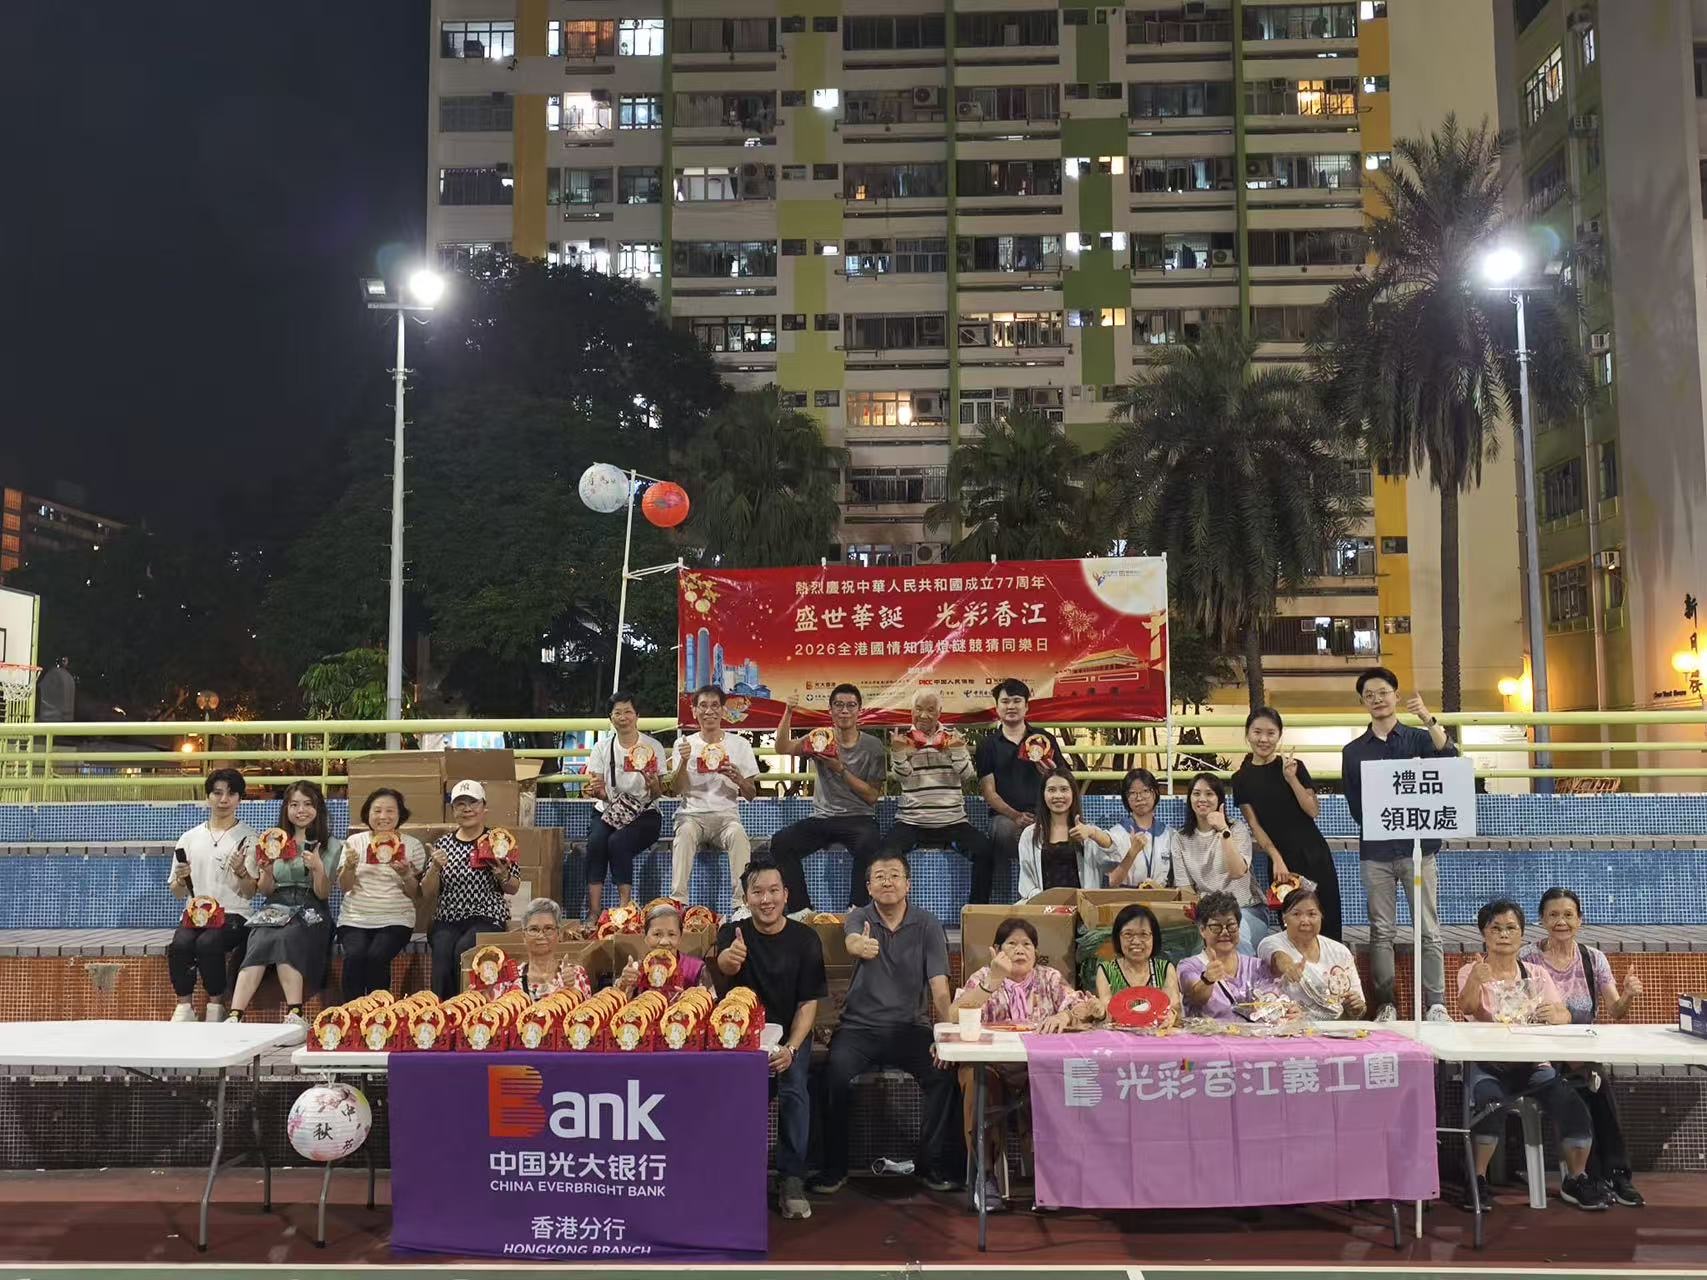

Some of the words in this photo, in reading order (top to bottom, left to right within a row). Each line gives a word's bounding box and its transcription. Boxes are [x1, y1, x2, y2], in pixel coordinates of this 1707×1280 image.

[795, 576, 1045, 595] 熱烈慶祝中華人民共和國成立77周年
[795, 603, 905, 632] 盛世華誕
[936, 600, 1047, 629] 光彩香江
[1392, 769, 1443, 795] 禮品
[1380, 805, 1458, 831] 領取處
[1116, 1052, 1400, 1101] 光彩香江義工團
[489, 1150, 667, 1181] 中国光大银行
[489, 1180, 534, 1192] CHINA
[538, 1181, 625, 1196] EVERBRIGHT
[627, 1185, 666, 1197] BANK
[531, 1215, 626, 1241] 香港分行
[503, 1243, 588, 1254] HONGKONG
